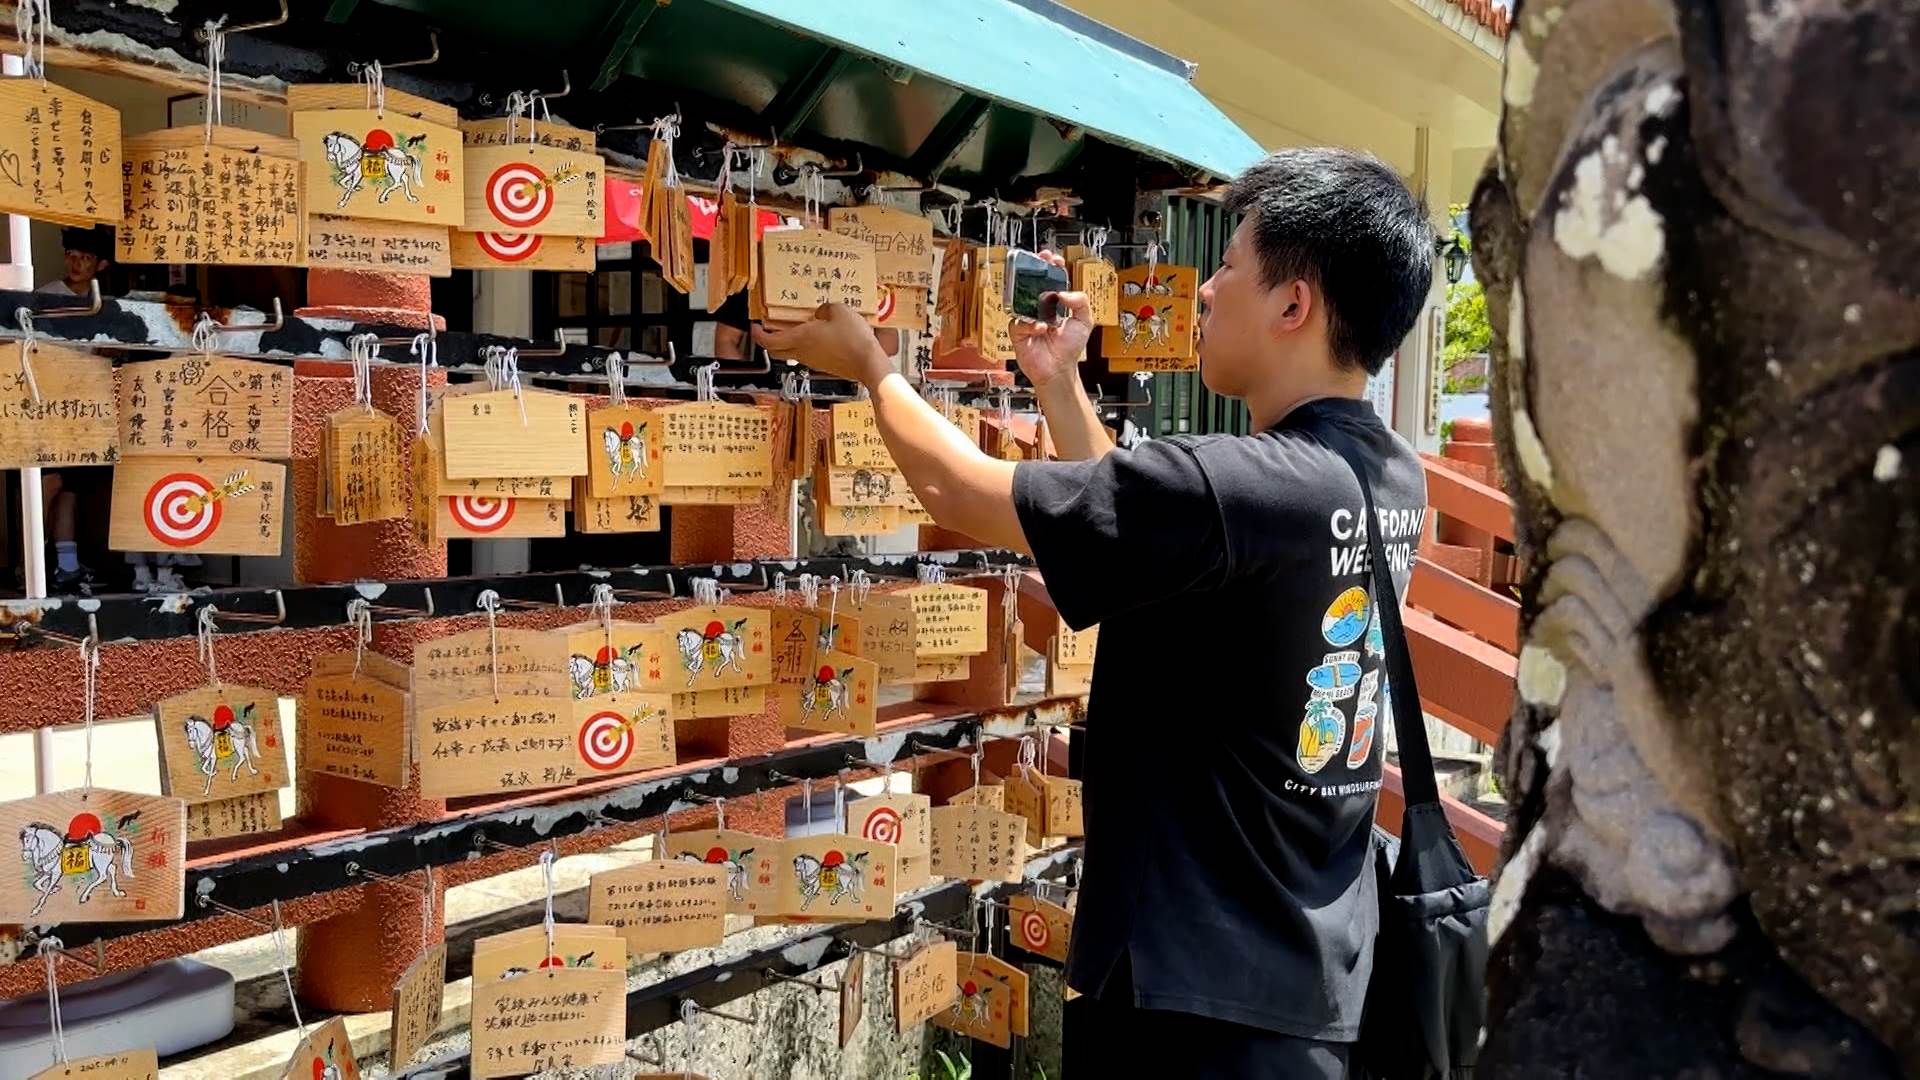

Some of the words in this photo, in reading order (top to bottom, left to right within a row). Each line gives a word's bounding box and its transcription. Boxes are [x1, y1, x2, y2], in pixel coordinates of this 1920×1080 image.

[434, 151, 451, 184] 祈願
[161, 387, 176, 448] 宮古島市
[194, 375, 240, 439] 合格
[1284, 779, 1317, 796] CITY
[66, 851, 86, 870] 福
[147, 827, 168, 869] 祈願
